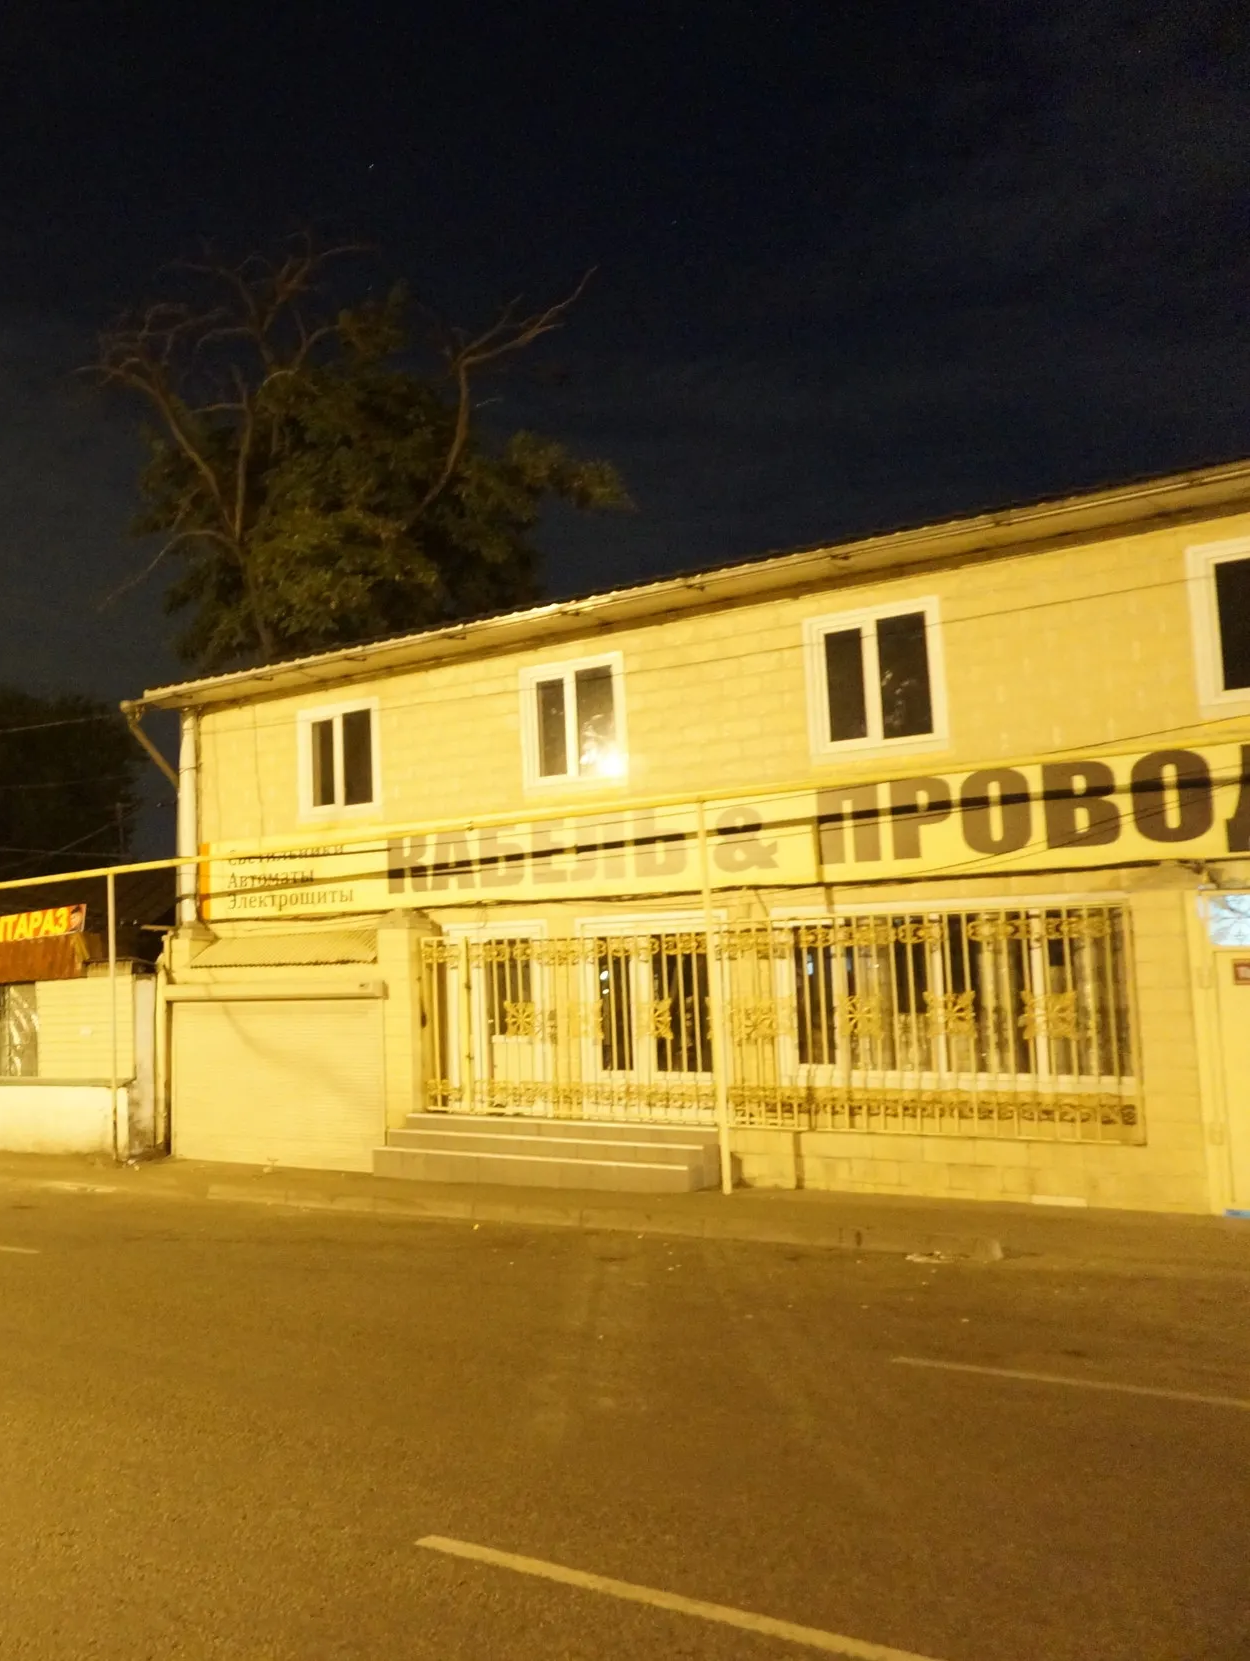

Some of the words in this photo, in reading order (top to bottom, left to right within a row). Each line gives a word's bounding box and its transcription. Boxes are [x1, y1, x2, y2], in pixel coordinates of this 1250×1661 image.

[387, 807, 687, 894] КАБЕЛЬ
[712, 806, 779, 873] &
[817, 744, 1250, 865] ПРОВО
[228, 869, 314, 889] Автоматы
[228, 888, 354, 912] Электрощиты
